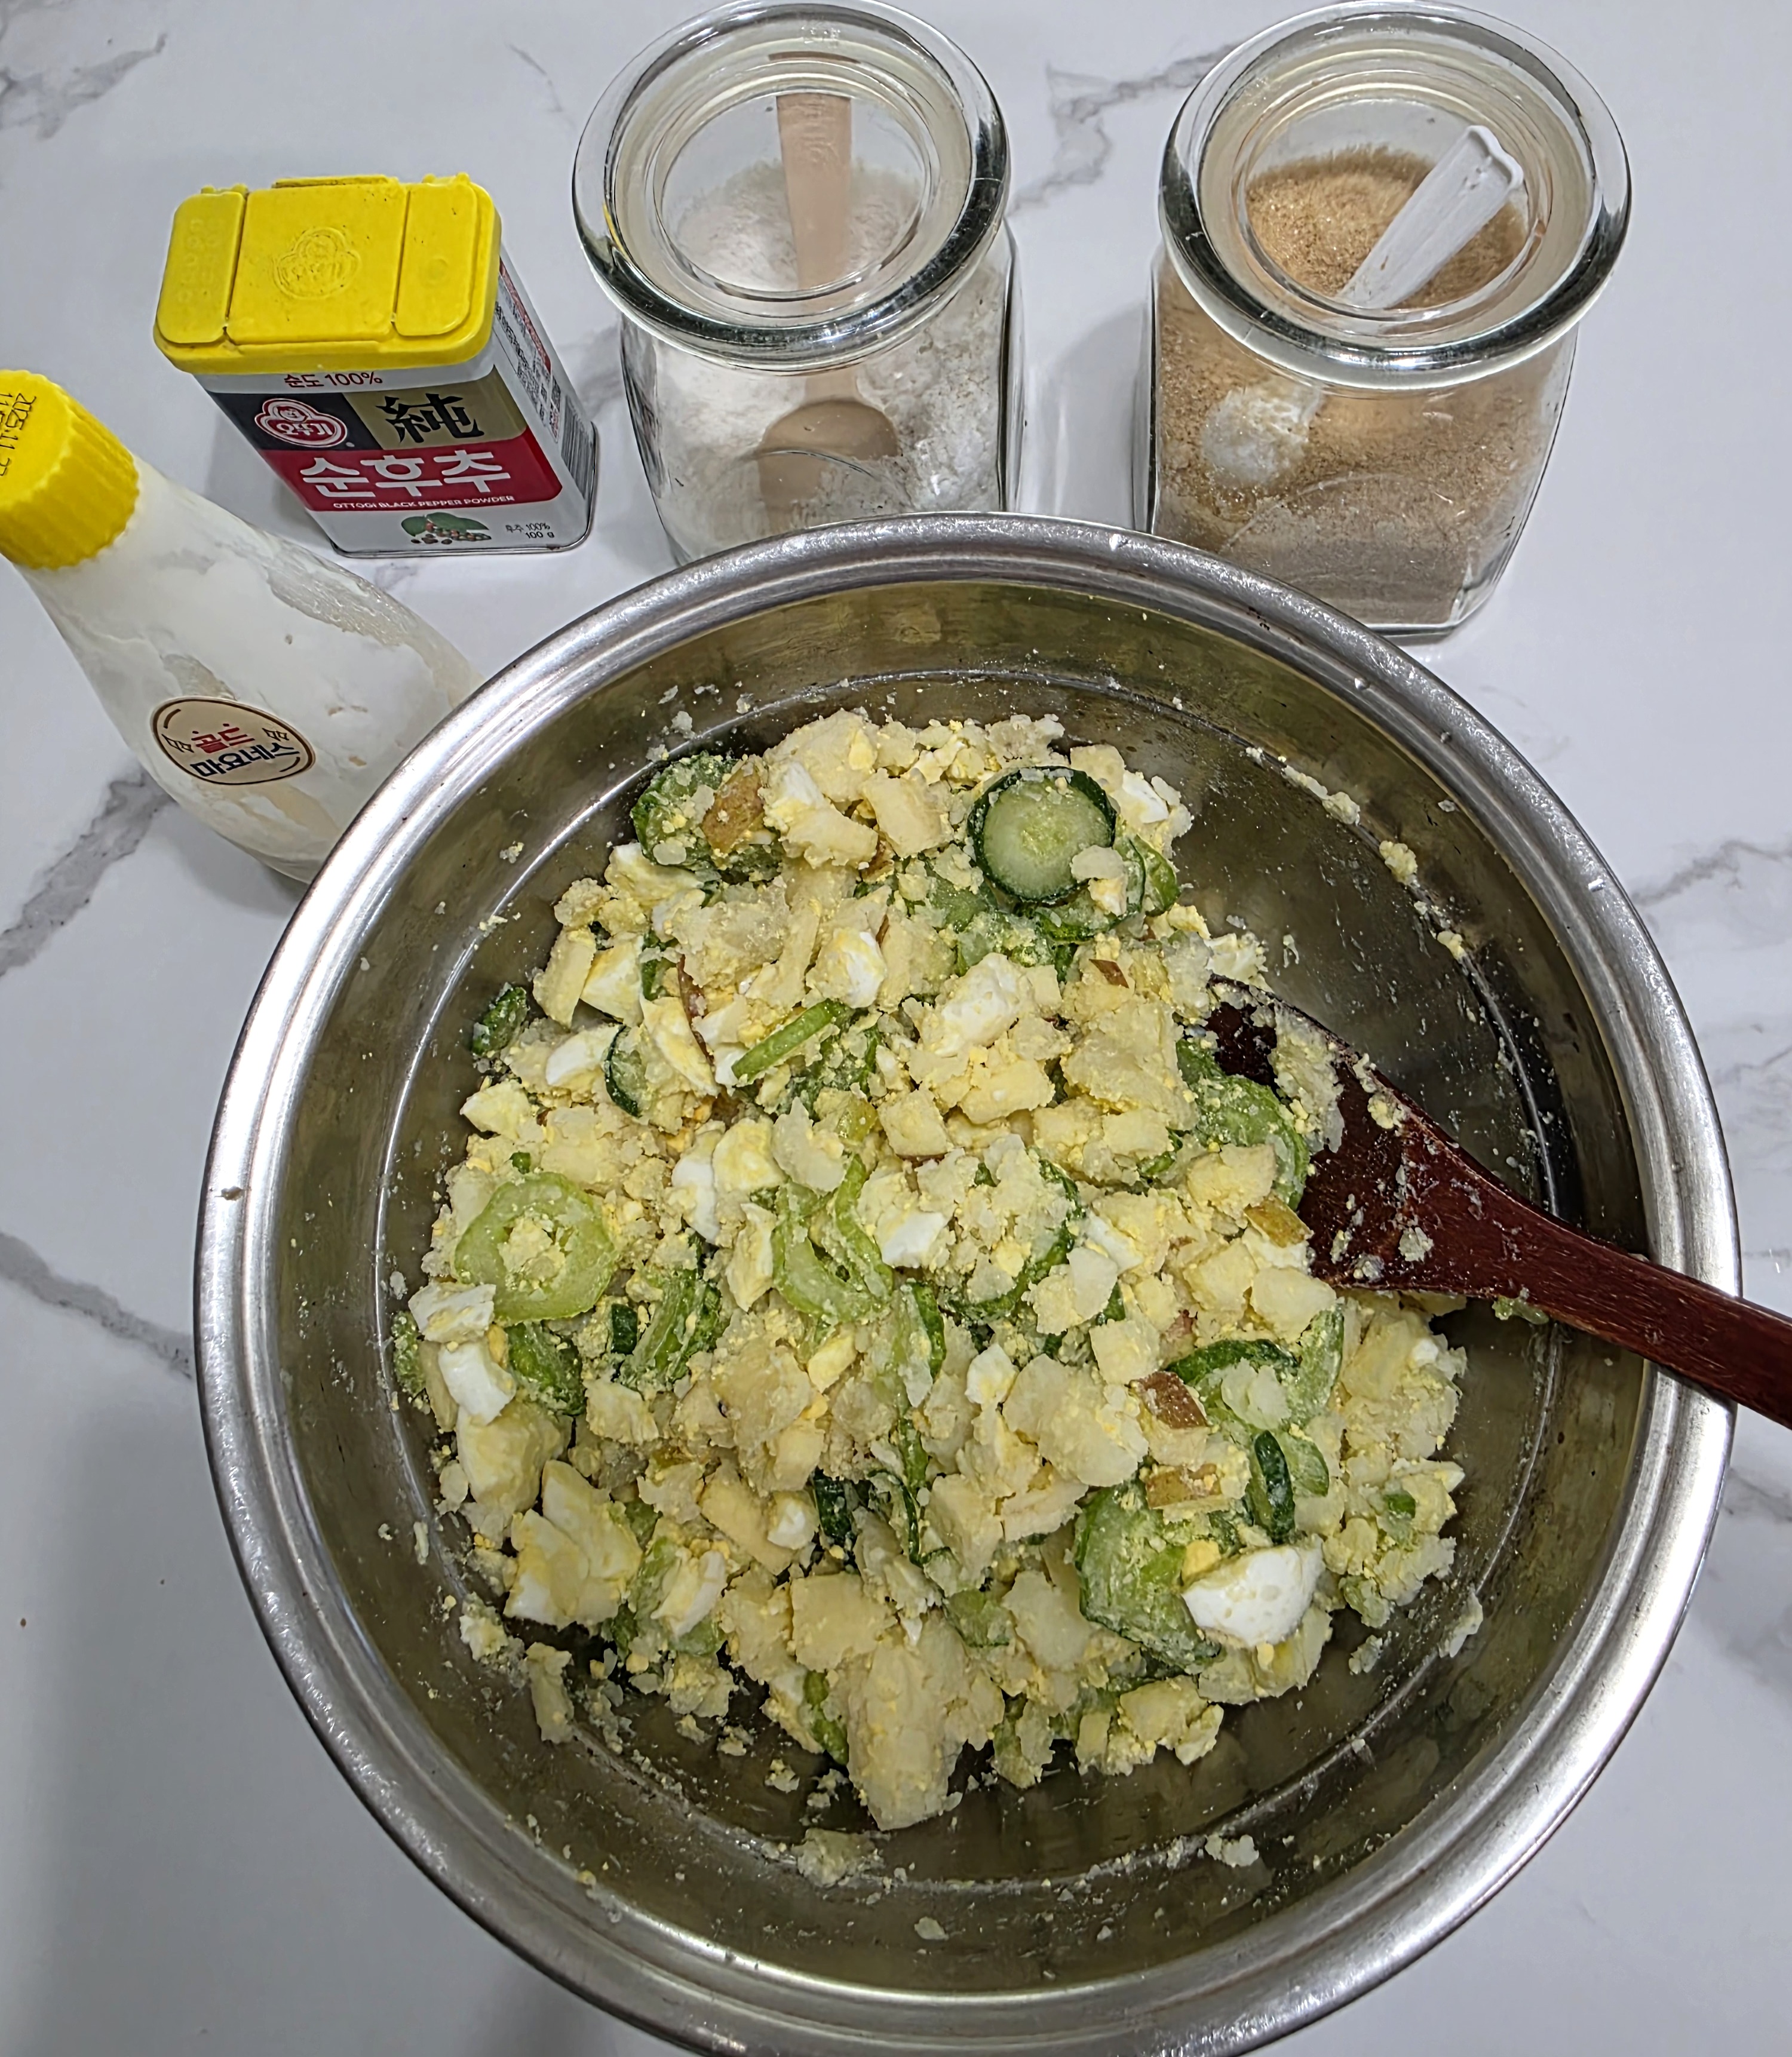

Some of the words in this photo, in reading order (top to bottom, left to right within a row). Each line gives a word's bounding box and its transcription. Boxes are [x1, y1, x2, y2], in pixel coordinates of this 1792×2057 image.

[284, 374, 324, 388] 순도
[324, 372, 383, 386] 100%
[276, 423, 333, 436] 오뚜기
[375, 392, 485, 444] 純
[299, 449, 511, 498] 순후추
[418, 499, 463, 507] PEPPER
[463, 495, 515, 505] POWDER
[526, 522, 551, 531] 100%
[191, 723, 256, 754] 골드
[189, 742, 300, 777] 마요네스
